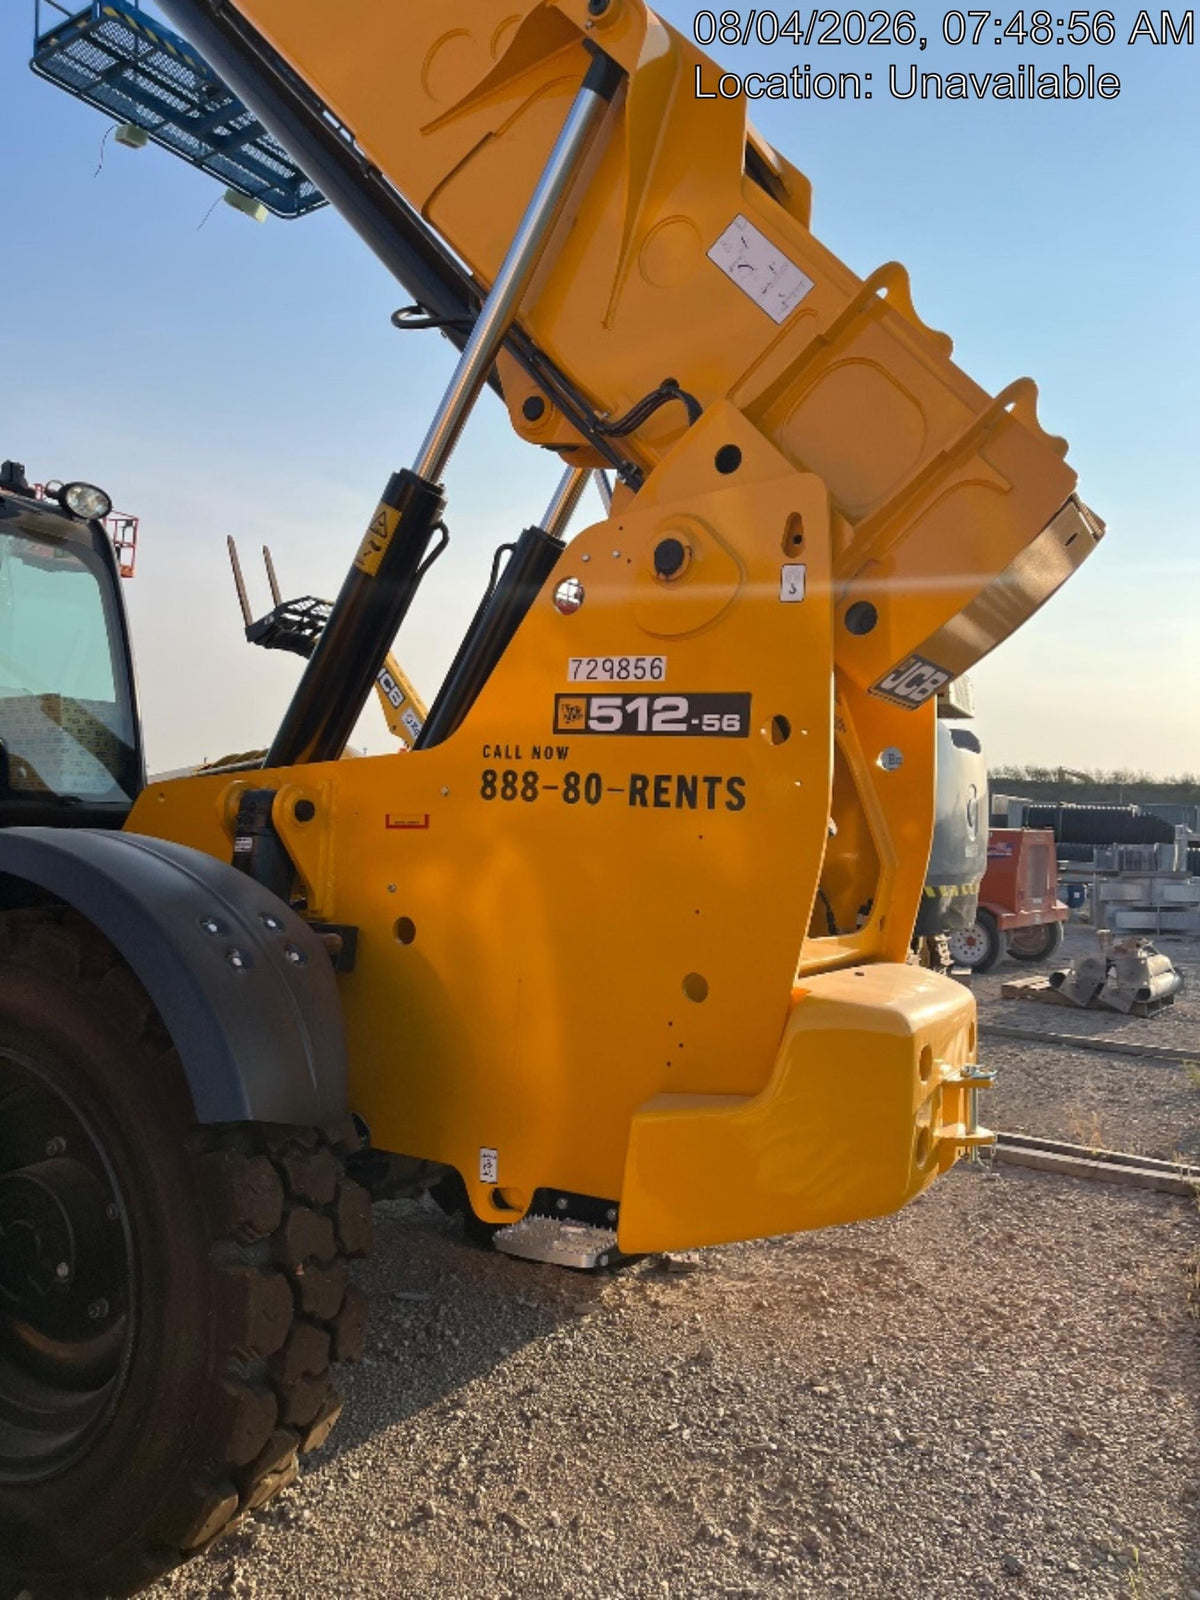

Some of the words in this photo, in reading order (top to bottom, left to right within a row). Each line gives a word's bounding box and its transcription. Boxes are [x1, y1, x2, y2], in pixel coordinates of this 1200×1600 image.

[571, 657, 663, 680] 729856
[880, 661, 949, 701] JCB
[482, 744, 522, 760] CALL
[531, 745, 570, 760] NOW
[480, 768, 747, 812] 888-80-RENTS
